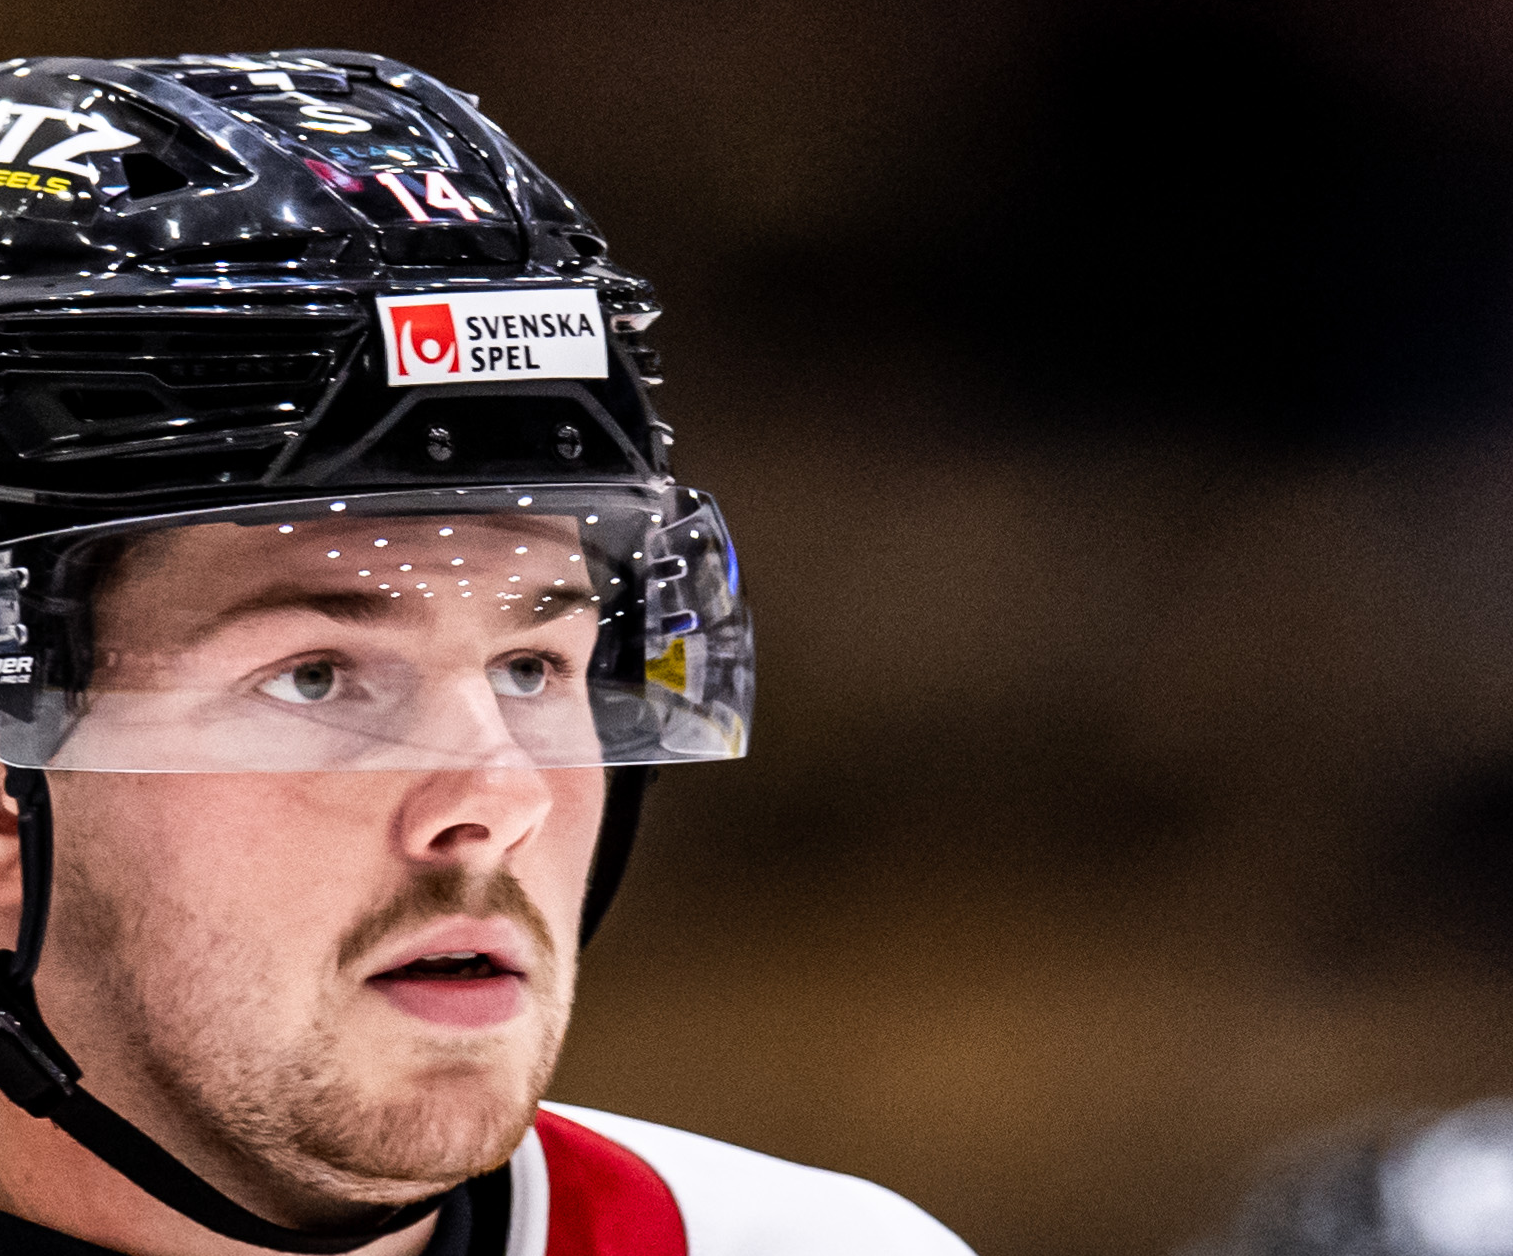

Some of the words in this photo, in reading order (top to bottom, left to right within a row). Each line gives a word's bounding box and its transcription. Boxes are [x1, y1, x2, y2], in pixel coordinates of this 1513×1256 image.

[375, 171, 480, 222] 14
[467, 314, 595, 341] SVENSKA
[471, 346, 541, 372] SPEL
